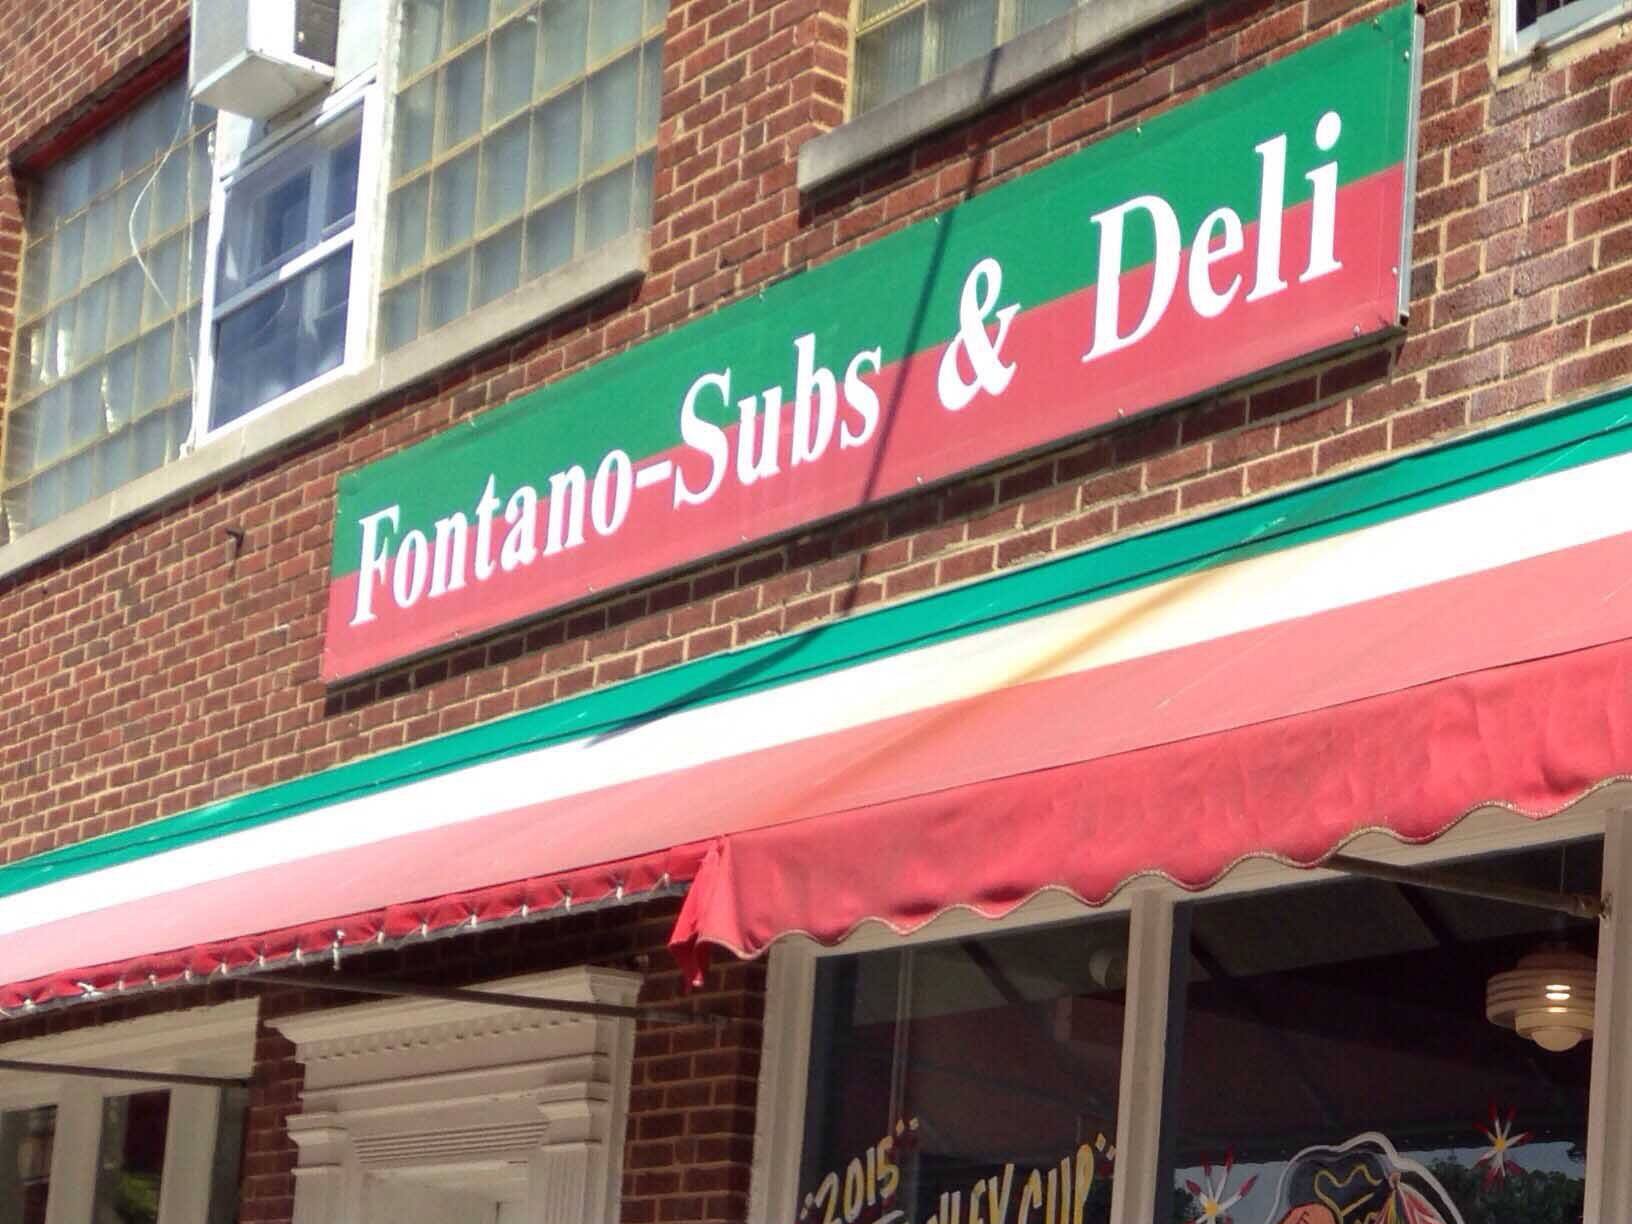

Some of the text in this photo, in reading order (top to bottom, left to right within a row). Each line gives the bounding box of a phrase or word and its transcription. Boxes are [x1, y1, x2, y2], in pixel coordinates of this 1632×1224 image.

[349, 111, 1342, 627] Fontano-Subs & Deli
